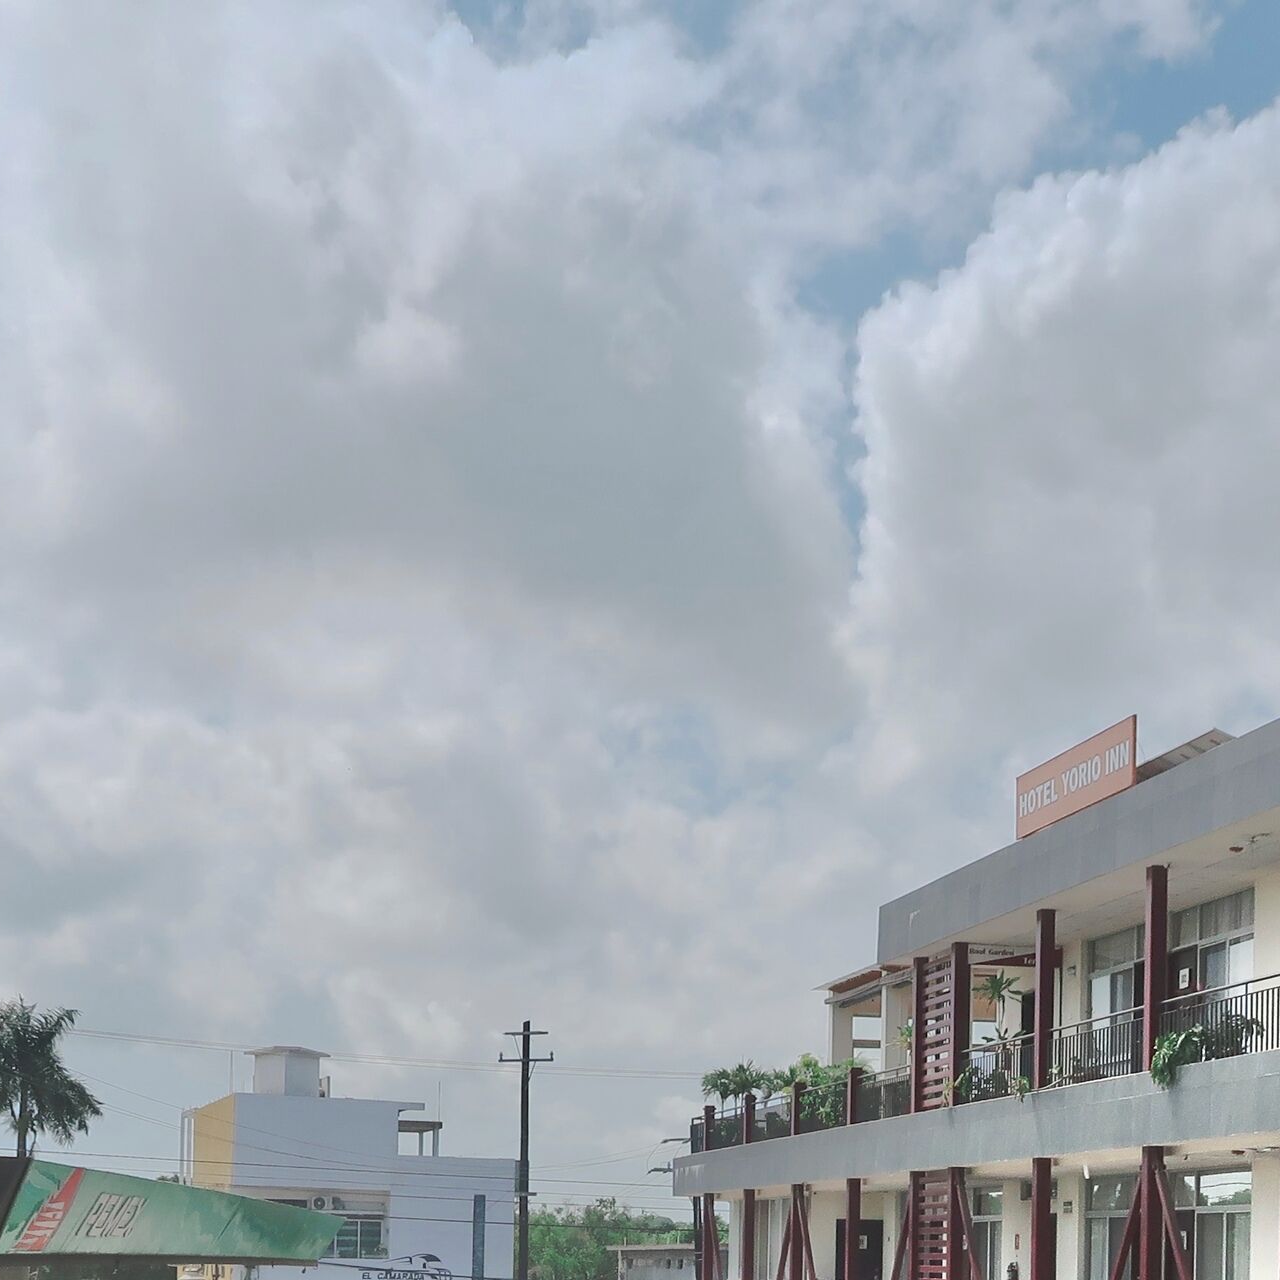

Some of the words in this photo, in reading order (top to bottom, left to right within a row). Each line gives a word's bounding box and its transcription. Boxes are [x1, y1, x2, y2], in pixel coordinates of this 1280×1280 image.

[1019, 779, 1058, 818] HOTEL
[1062, 755, 1101, 796] YORIO
[1105, 740, 1129, 776] INN
[362, 1272, 371, 1280] EL
